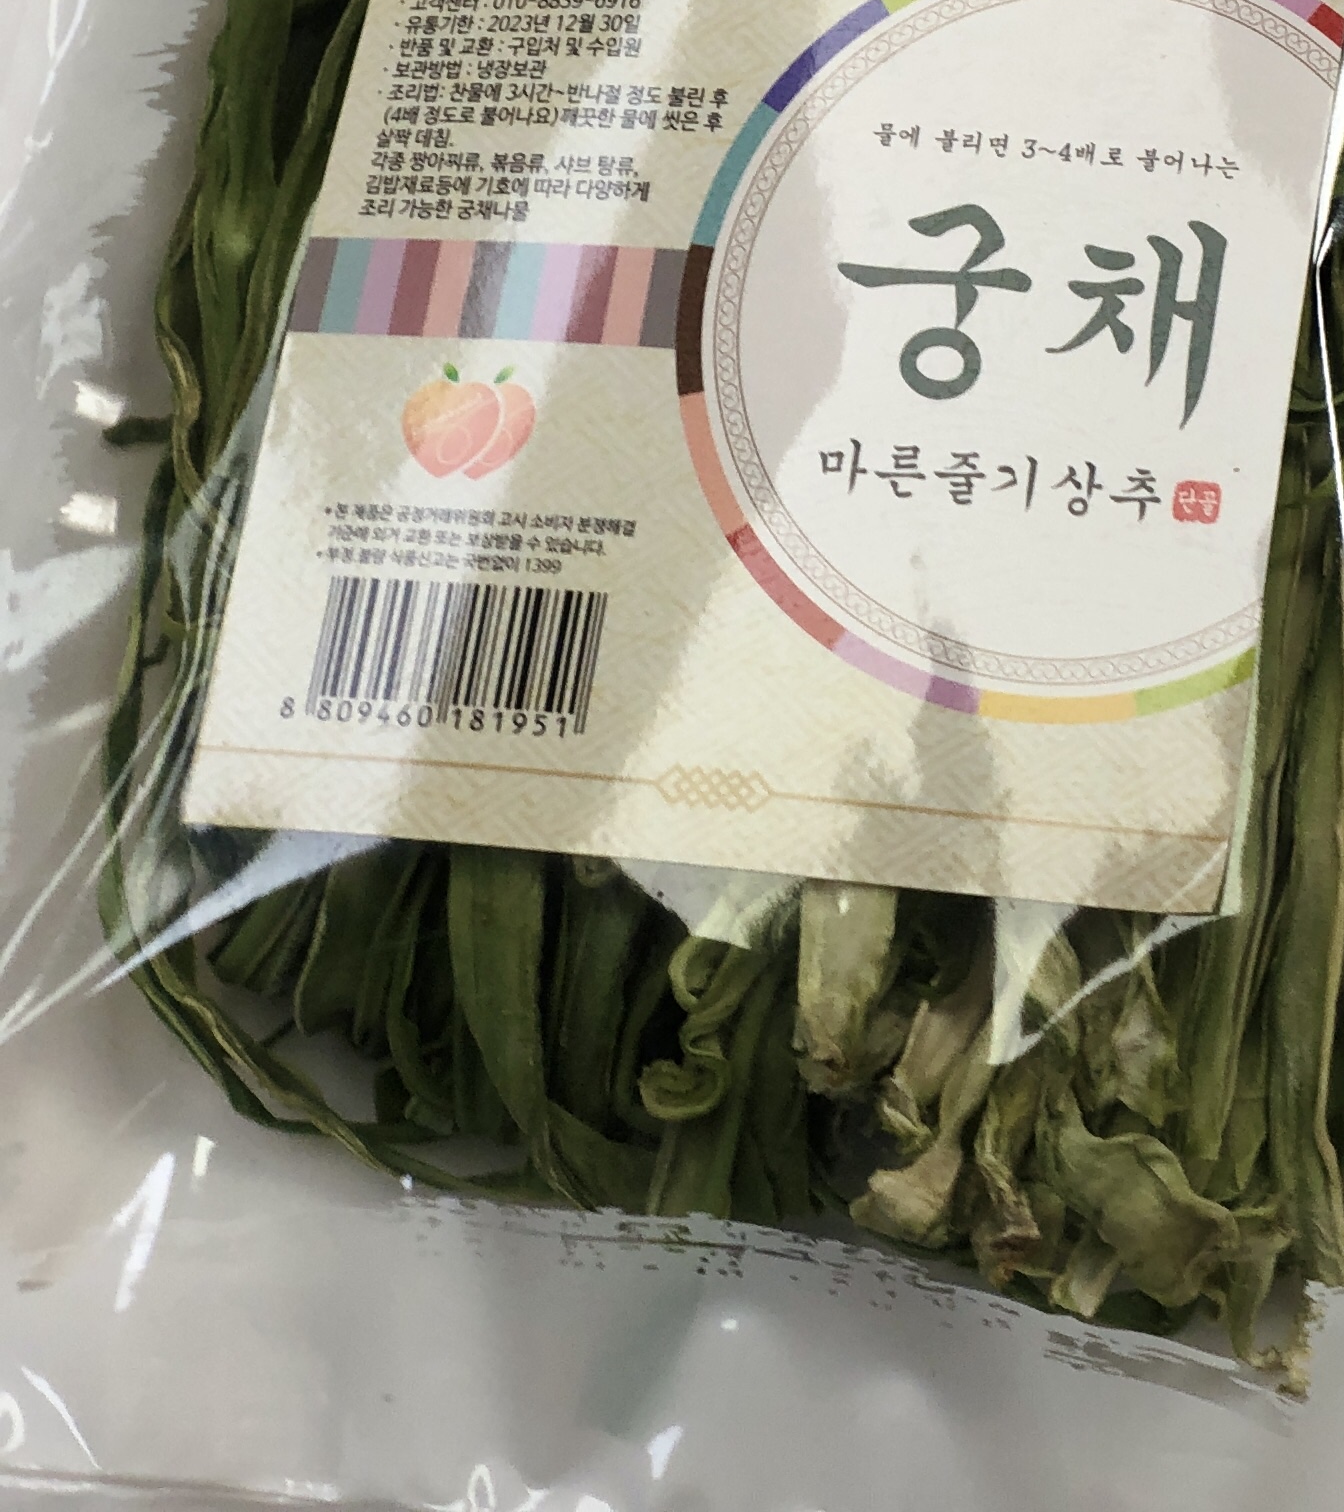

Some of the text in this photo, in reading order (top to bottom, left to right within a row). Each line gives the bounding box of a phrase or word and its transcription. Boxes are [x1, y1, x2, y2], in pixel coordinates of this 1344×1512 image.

[486, 13, 550, 34] 2023년
[556, 13, 595, 33] 12월
[598, 13, 641, 34] 30일
[400, 38, 434, 58] 반품
[438, 38, 457, 57] 및
[507, 37, 560, 57] 구입처
[565, 37, 582, 57] 및
[587, 37, 642, 58] 수입원
[476, 59, 547, 80] 냉장보관
[627, 85, 661, 105] 정도
[668, 86, 705, 108] 불린
[709, 88, 729, 109] 후
[424, 106, 475, 125] 정도로
[619, 108, 657, 129] 물에
[662, 110, 699, 132] 씻은
[703, 111, 723, 132] 후
[371, 152, 405, 172] 각종
[874, 122, 1241, 180] 물에 불리면 3~4배로 불어나는
[475, 176, 529, 197] 기호에
[534, 178, 571, 199] 따라
[575, 179, 650, 202] 다양하게
[358, 198, 395, 218] 조리
[398, 198, 453, 220] 가능한
[837, 203, 1228, 431] 궁채
[818, 438, 1162, 523] 마른줄기상추
